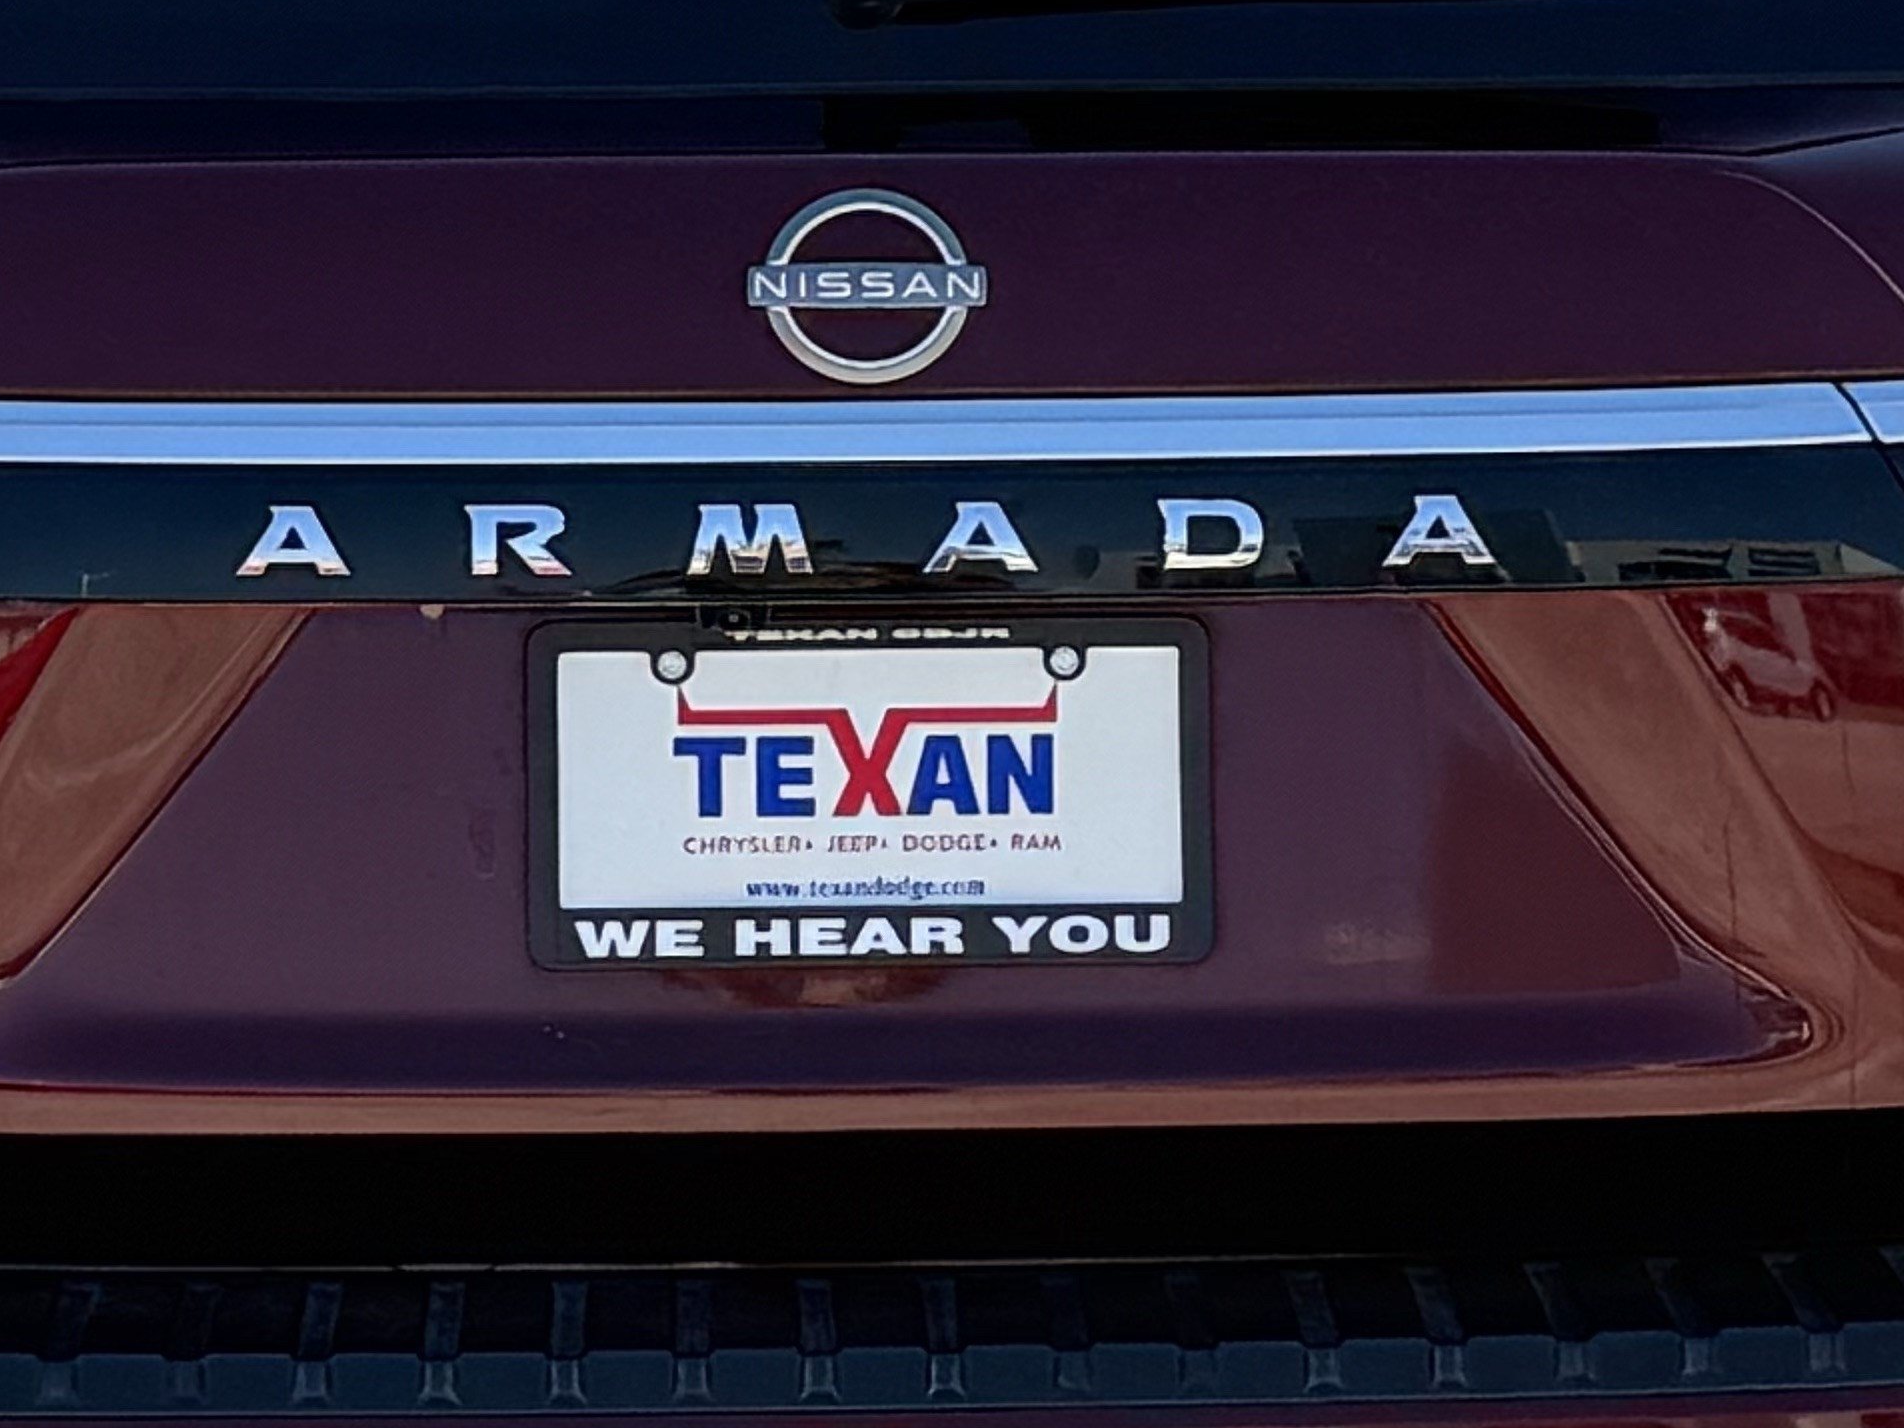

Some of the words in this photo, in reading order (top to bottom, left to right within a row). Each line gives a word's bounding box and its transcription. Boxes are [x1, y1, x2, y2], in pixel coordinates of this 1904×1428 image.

[754, 271, 981, 299] NISSAN
[234, 493, 1498, 577] ARMADA
[672, 706, 1054, 819] TEXAN
[682, 835, 801, 854] CHRYSLER
[901, 834, 987, 852] DODGE
[1010, 833, 1062, 851] RAM
[745, 876, 986, 900] www.texandodge.com
[574, 919, 706, 960] WE
[734, 916, 966, 957] HEAR
[991, 913, 1172, 954] YOU
